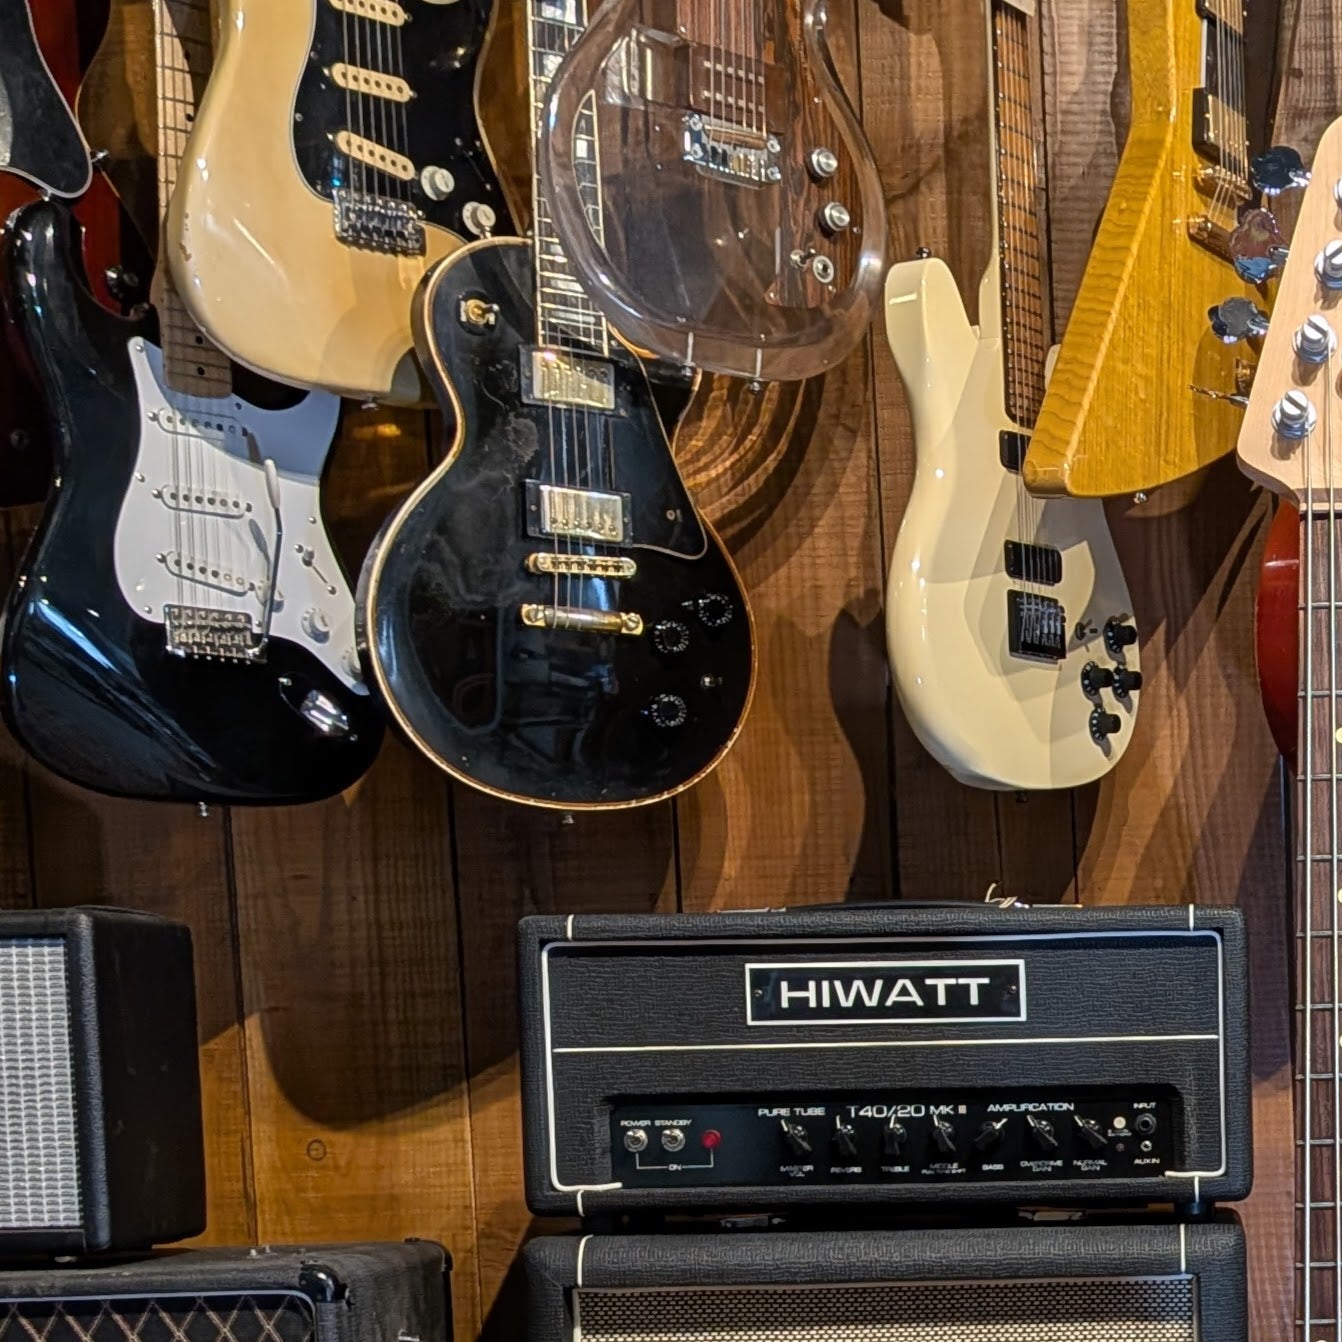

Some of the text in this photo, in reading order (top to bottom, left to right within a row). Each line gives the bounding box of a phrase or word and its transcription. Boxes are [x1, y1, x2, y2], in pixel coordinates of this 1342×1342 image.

[780, 977, 990, 1009] HIWATT
[758, 1107, 826, 1117] PURE TUBE
[847, 1104, 925, 1118] T40/20
[929, 1104, 954, 1114] MK
